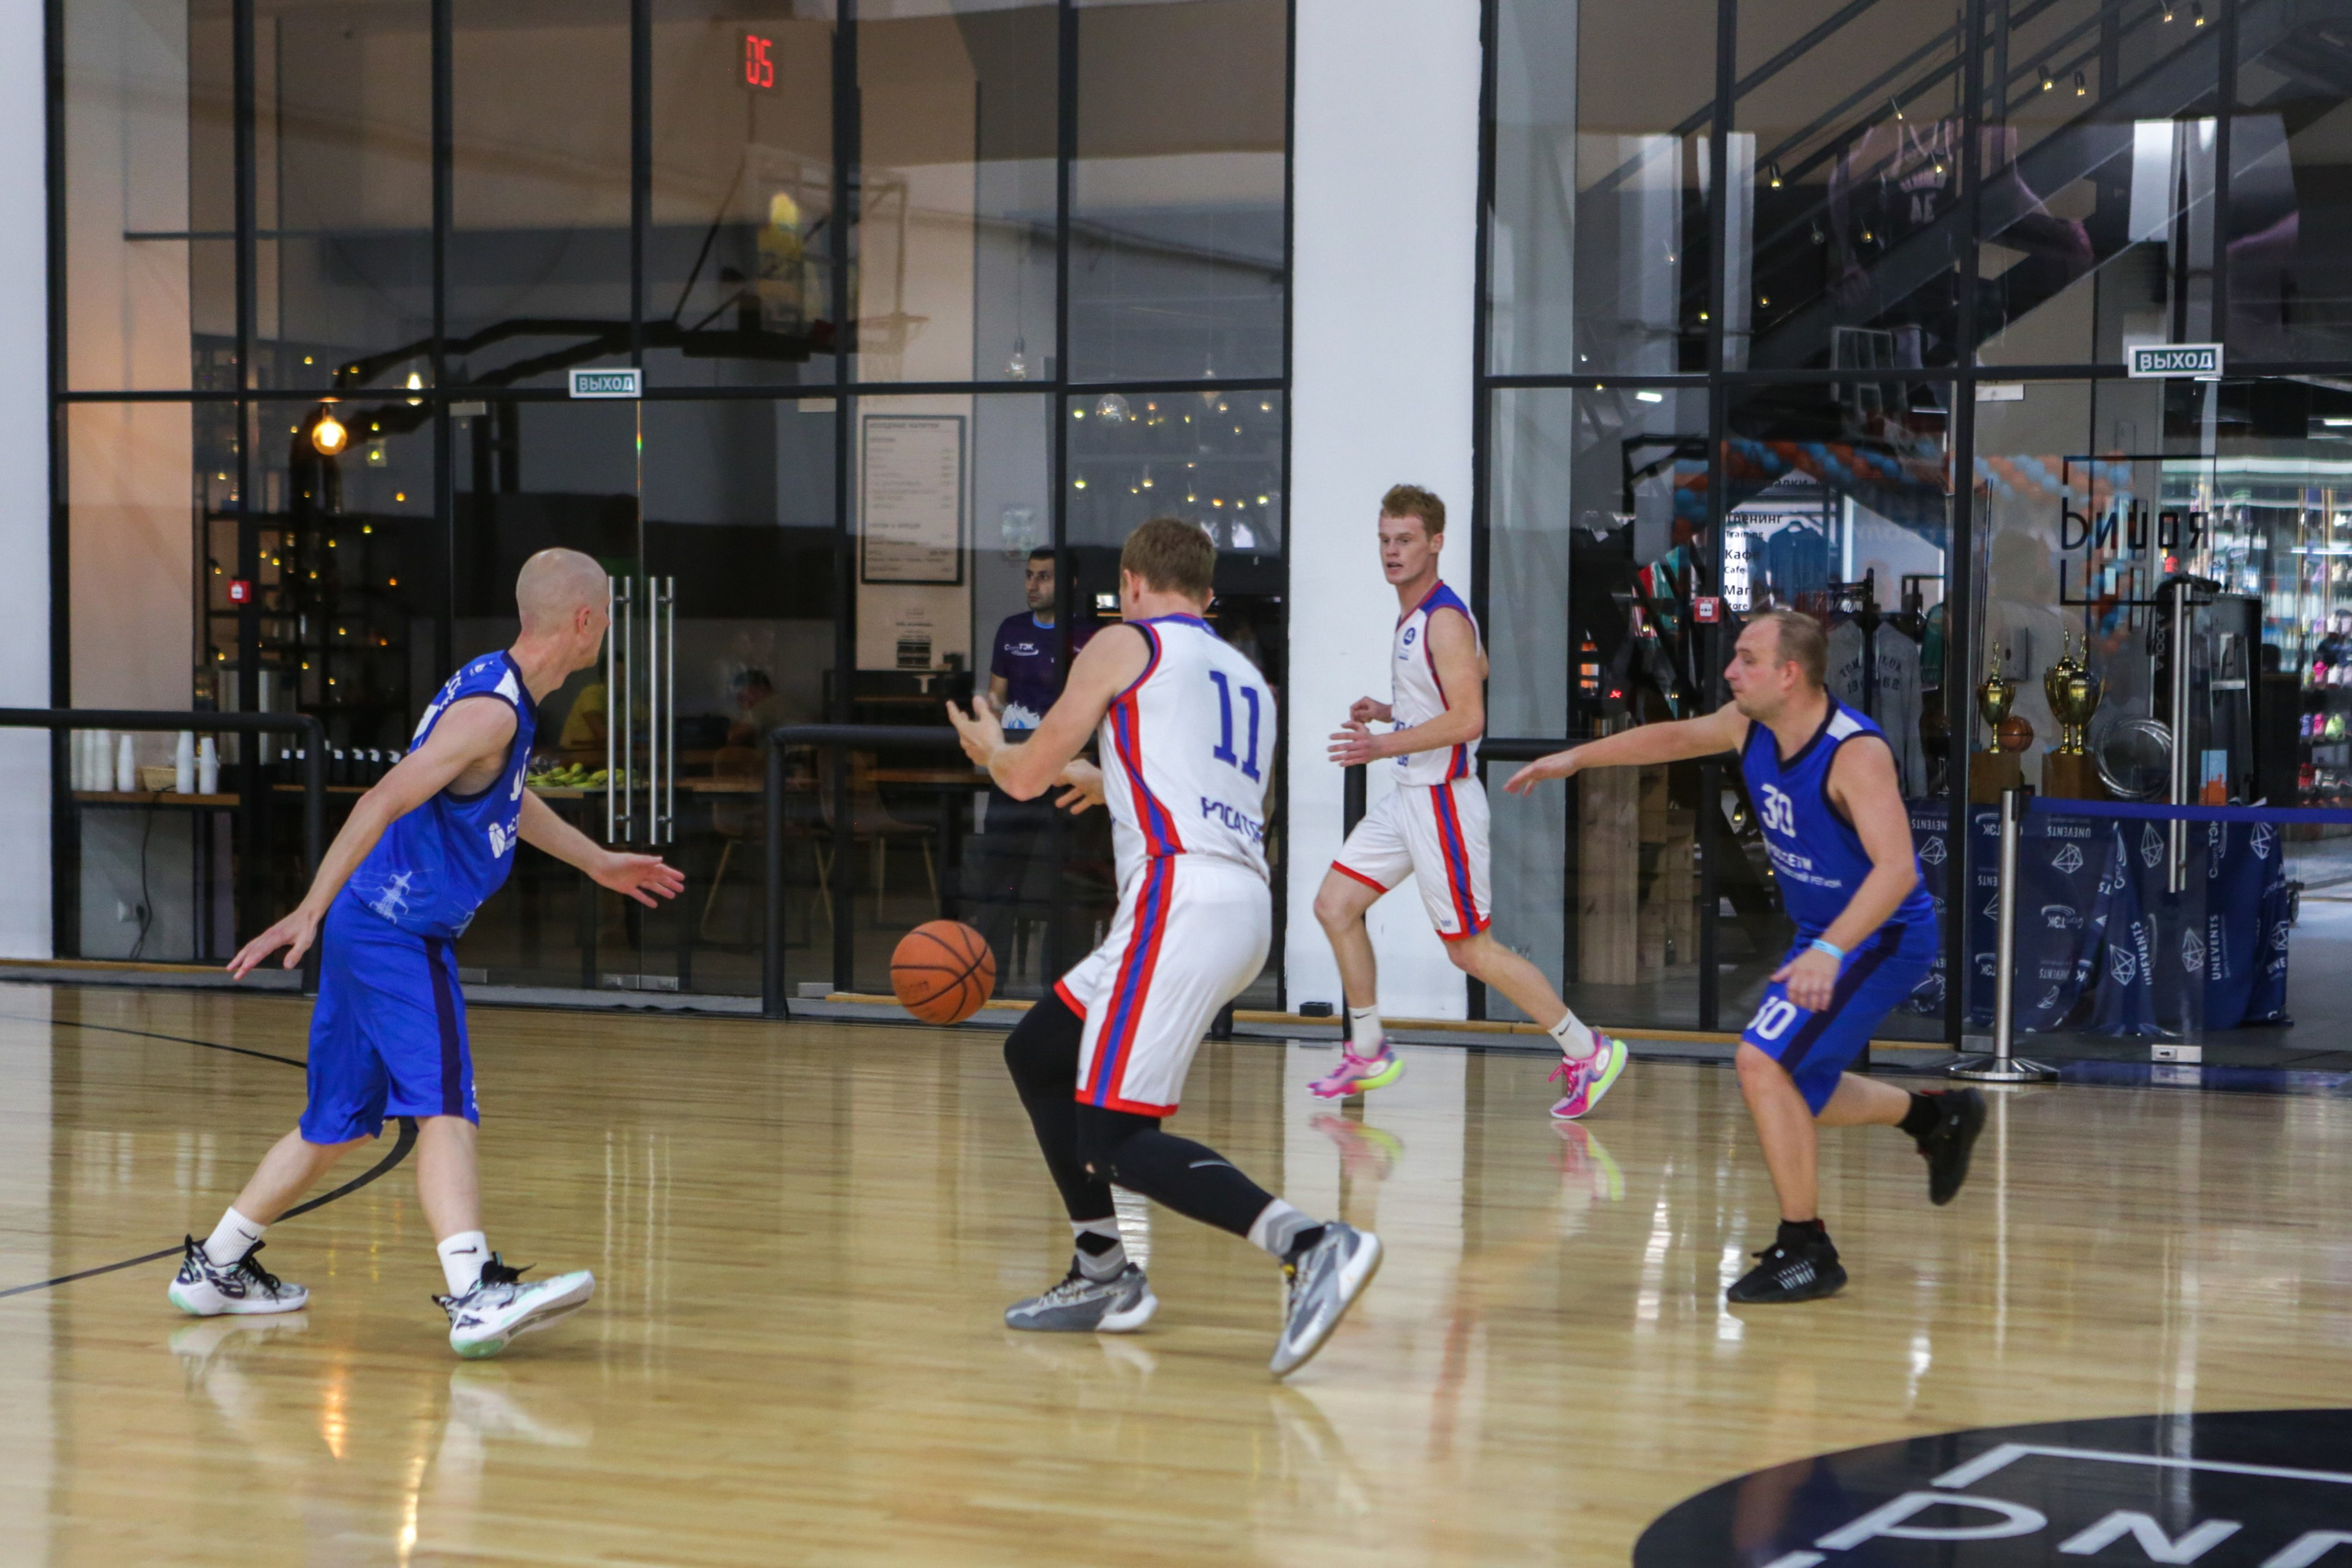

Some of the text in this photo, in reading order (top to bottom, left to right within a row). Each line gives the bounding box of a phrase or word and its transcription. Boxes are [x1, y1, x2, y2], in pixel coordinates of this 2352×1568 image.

[745, 35, 774, 88] 05
[2140, 353, 2213, 370] ВЫХОД
[579, 377, 634, 391] ВЫХОД
[1725, 530, 1763, 540] Training
[1724, 566, 1745, 574] Cafe
[1727, 601, 1748, 610] tore
[1209, 670, 1261, 784] 11
[1761, 784, 1796, 839] 30
[1911, 818, 1948, 831] NEVENTS
[2047, 826, 2091, 838] UNEVENTS
[2210, 915, 2222, 981] UNEVENTS
